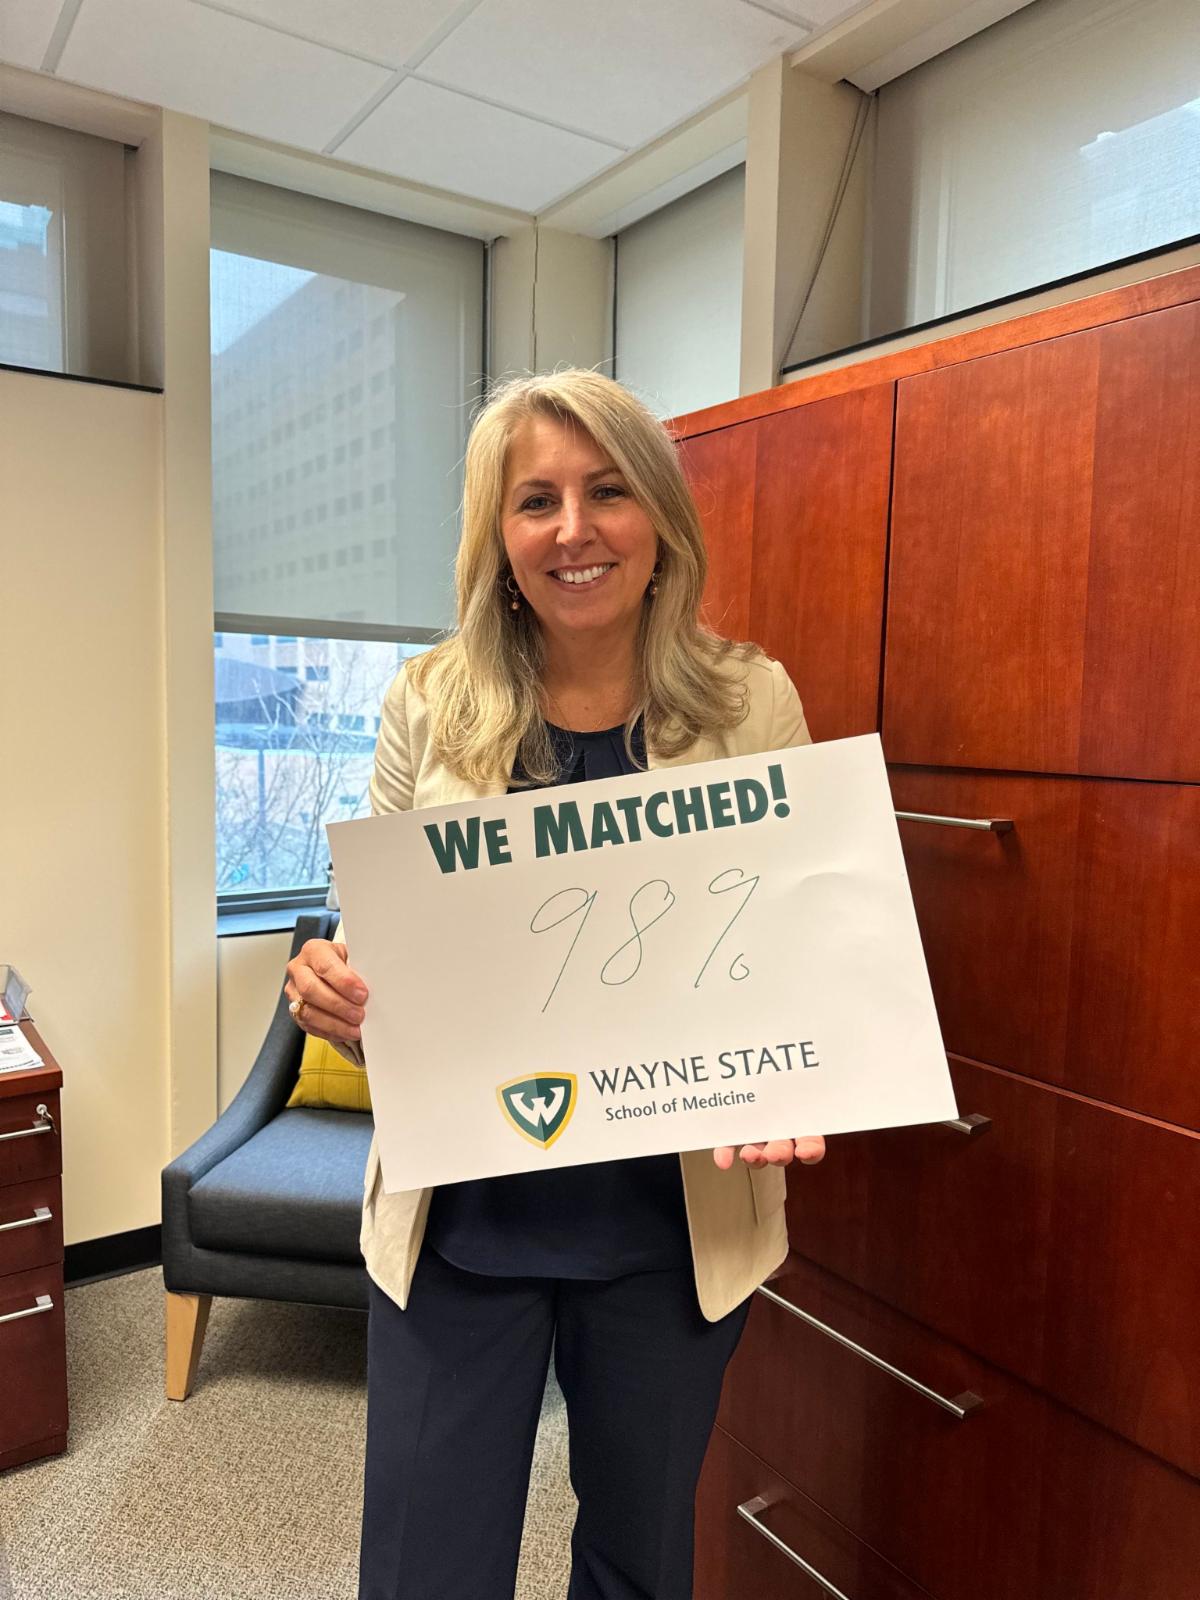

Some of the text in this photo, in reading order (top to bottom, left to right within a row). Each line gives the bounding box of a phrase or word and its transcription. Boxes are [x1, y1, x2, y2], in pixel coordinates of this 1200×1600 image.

[423, 764, 791, 874] WE MATCHED!
[530, 868, 760, 1013] 98%
[589, 1041, 820, 1096] WAYNE STATE
[605, 1089, 757, 1121] School of Medicine
